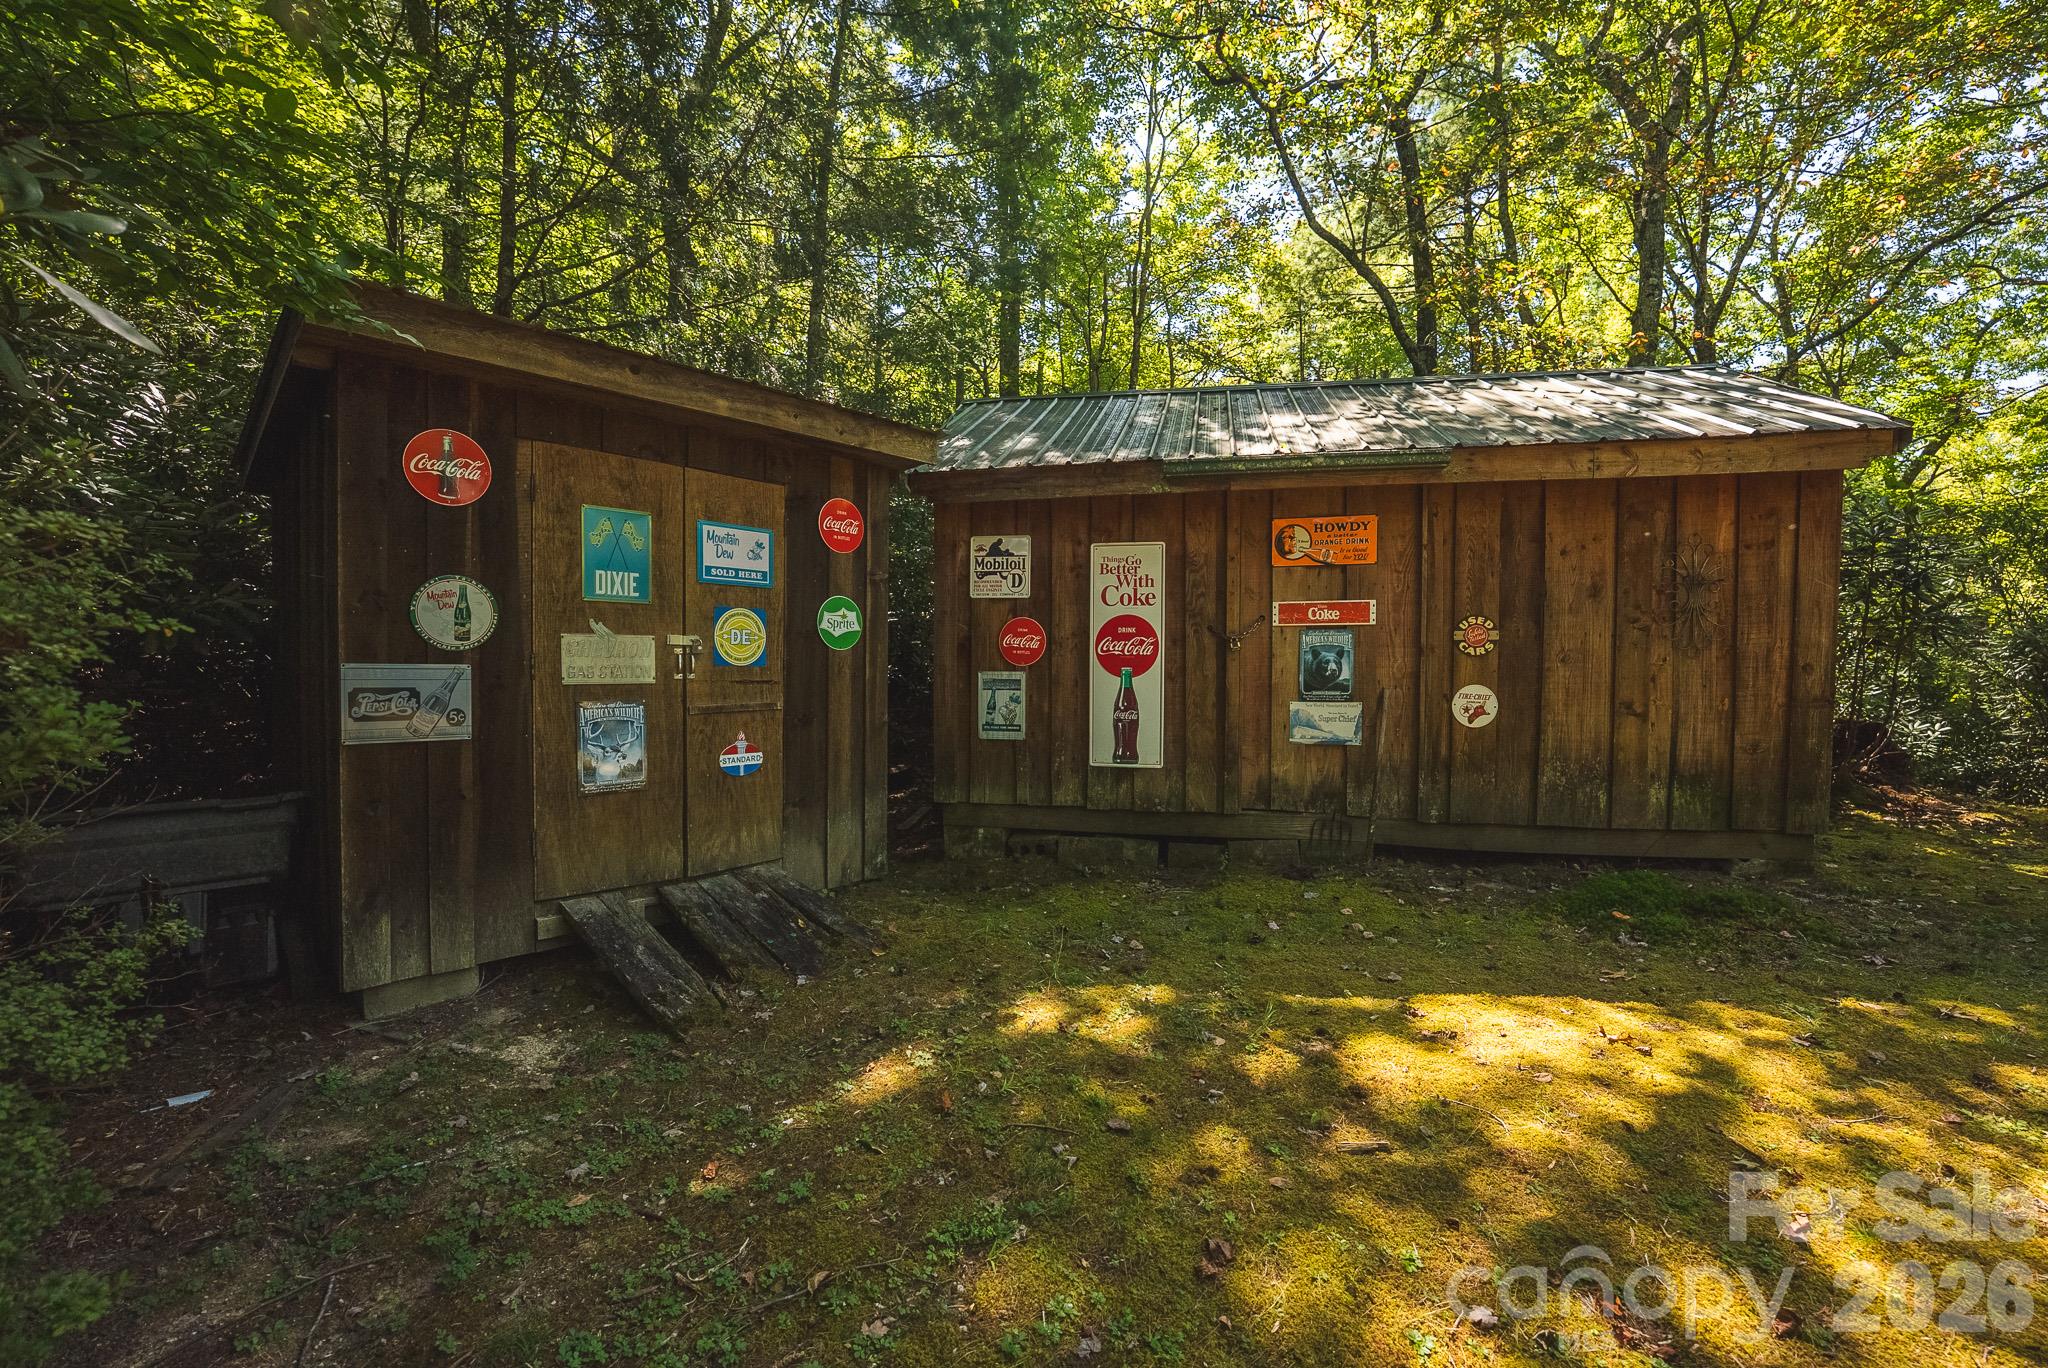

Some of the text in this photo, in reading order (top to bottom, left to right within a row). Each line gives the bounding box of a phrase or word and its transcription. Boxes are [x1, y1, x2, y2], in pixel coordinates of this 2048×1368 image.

[410, 453, 485, 481] Coca-Cola
[823, 515, 860, 535] Coca-Cola
[1313, 520, 1372, 533] HOWDY
[706, 529, 740, 547] Mountain
[1314, 538, 1343, 547] ORANGE
[1345, 537, 1370, 545] DRINK
[713, 543, 735, 560] Dew
[974, 556, 1027, 571] Mobiloil
[1101, 555, 1142, 566] Things Go
[710, 567, 764, 580] SOLD HERE
[1099, 562, 1141, 576] Better
[594, 569, 640, 597] DIXIE
[1010, 572, 1024, 588] D
[1116, 574, 1156, 589] With
[426, 589, 458, 603] Mountain
[1100, 584, 1157, 607] Coke
[438, 599, 455, 611] Dew
[1307, 606, 1341, 621] Coke
[827, 617, 856, 632] Sprite
[1458, 616, 1495, 630] USED
[730, 628, 752, 645] DE
[1003, 633, 1042, 649] Coca-Cola
[1097, 636, 1157, 656] Coca-Cola
[1458, 641, 1495, 656] CARS
[567, 664, 595, 679] GAS
[448, 710, 466, 724] 5¢
[579, 705, 645, 727] AMERICA'S WILDLIFE
[1318, 714, 1338, 723] Super
[722, 754, 761, 765] STANDARD
